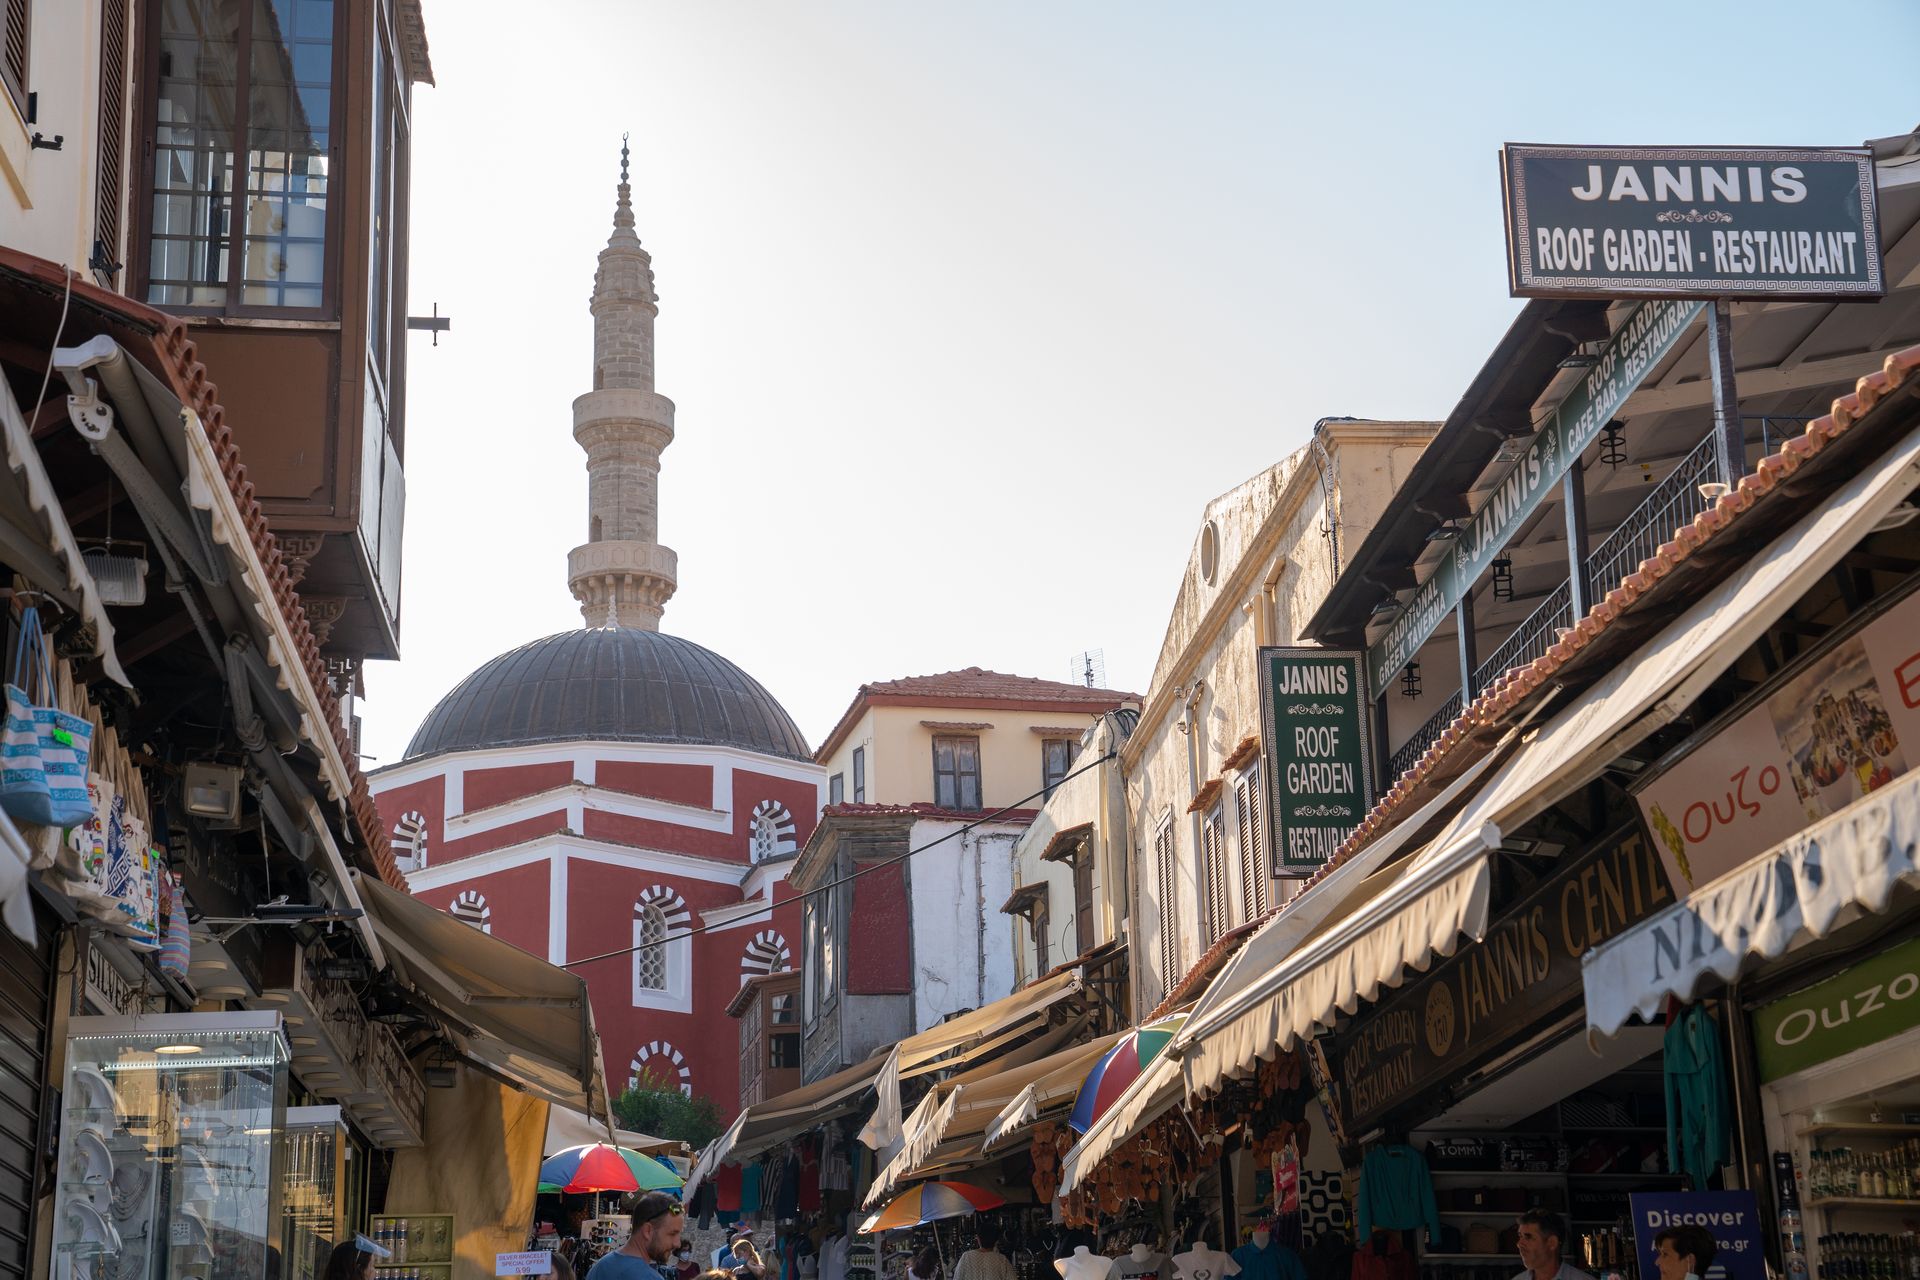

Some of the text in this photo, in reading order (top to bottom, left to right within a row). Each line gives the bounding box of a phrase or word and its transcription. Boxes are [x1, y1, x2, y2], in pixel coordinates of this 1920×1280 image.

[1571, 165, 1808, 202] JANNIS
[1537, 227, 1596, 271] ROOF
[1603, 228, 1694, 273] GARDEN
[1712, 230, 1857, 275] RESTAURANT
[1587, 300, 1670, 400] ROOF GARDE
[1568, 405, 1594, 452] CAFE
[1595, 378, 1617, 420] BAR
[1472, 444, 1541, 562] JANNIS
[1379, 592, 1446, 685] GREEK TAVERNA
[1383, 577, 1438, 657] TRADITIONAL
[1279, 665, 1348, 695] JANNIS
[1295, 726, 1339, 758] ROOF
[1287, 762, 1354, 794] GARDEN
[1288, 826, 1356, 859] RESTAURA
[1459, 904, 1551, 1043] JANNIS
[1775, 972, 1920, 1046] Ouzo
[1344, 1009, 1417, 1089] ROOF GARDEN
[1350, 1048, 1413, 1120] RESTAURANT
[1440, 1144, 1484, 1157] TOMMY
[1647, 1209, 1744, 1228] Discover
[518, 1252, 547, 1260] BRACELET
